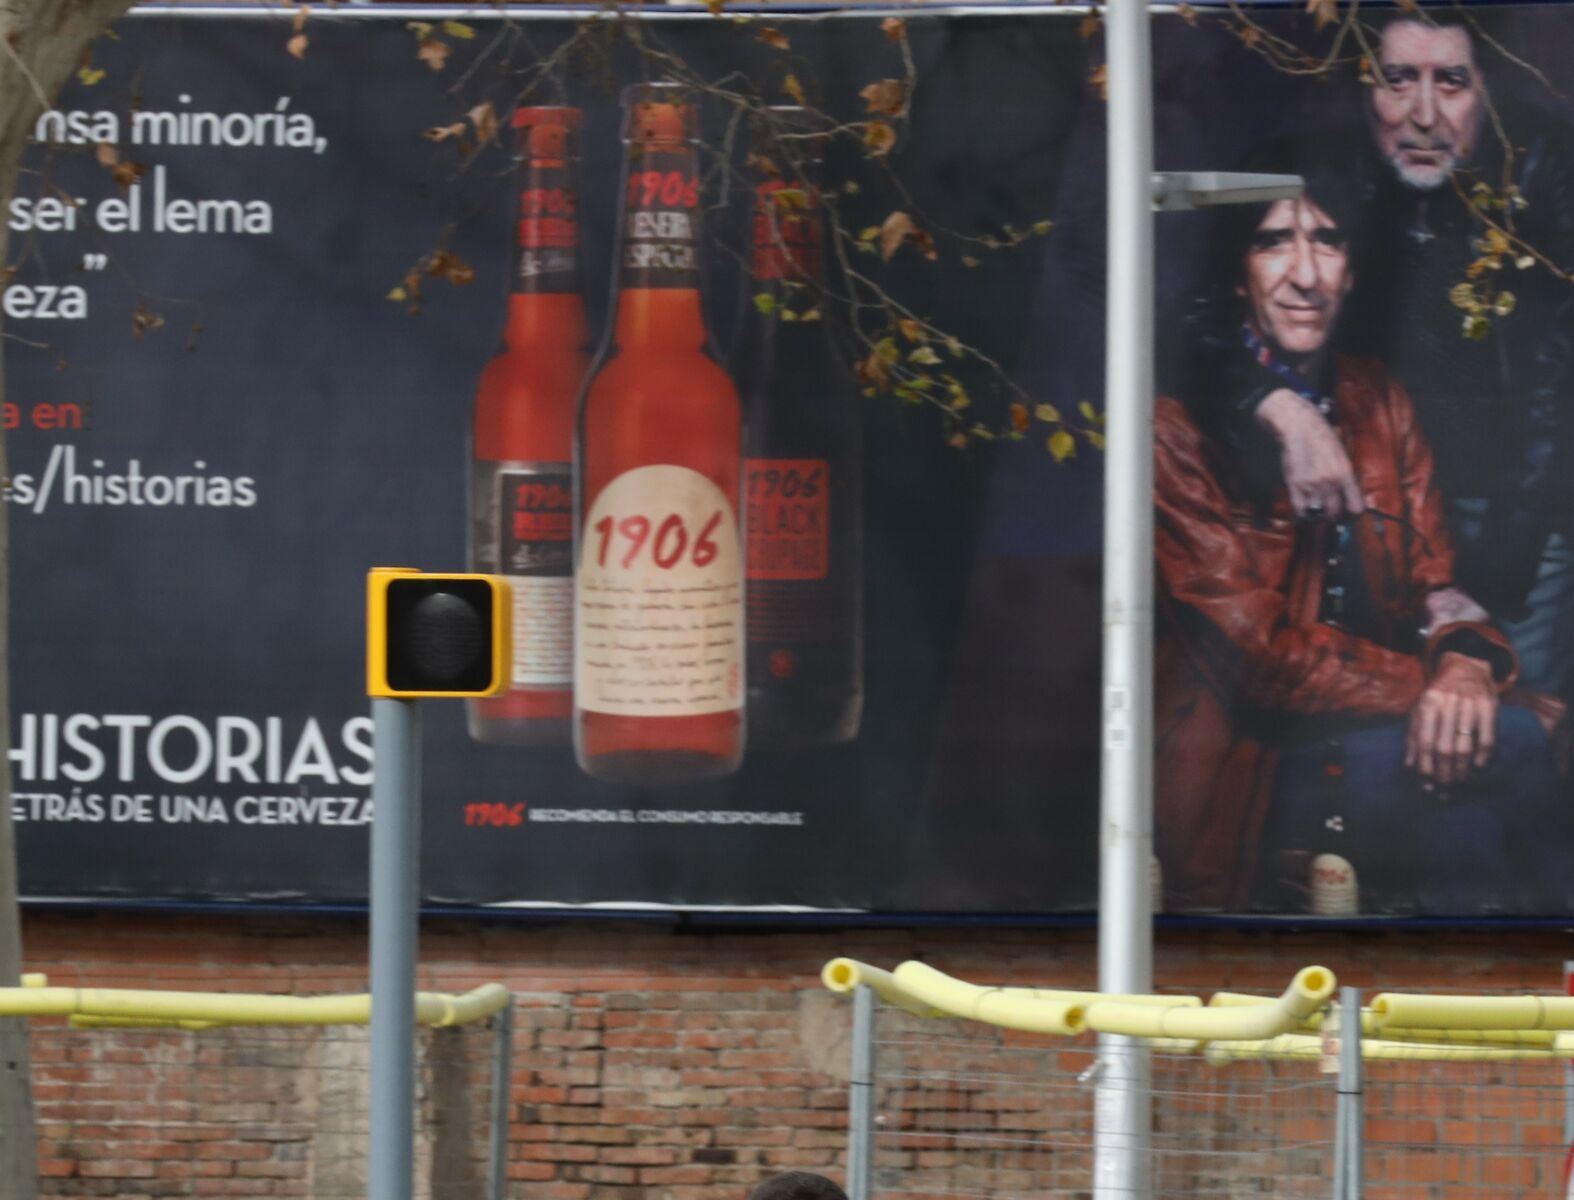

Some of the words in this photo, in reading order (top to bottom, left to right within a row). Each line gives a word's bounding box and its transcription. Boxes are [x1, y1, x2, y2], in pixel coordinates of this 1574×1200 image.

[132, 93, 328, 154] minoría,
[7, 197, 87, 232] ser
[95, 184, 141, 233] el
[153, 164, 273, 234] lema
[32, 402, 83, 430] en
[594, 509, 722, 569] 1906
[7, 712, 375, 785] HISTORIAS
[110, 793, 154, 823] DE
[159, 795, 229, 824] UNA
